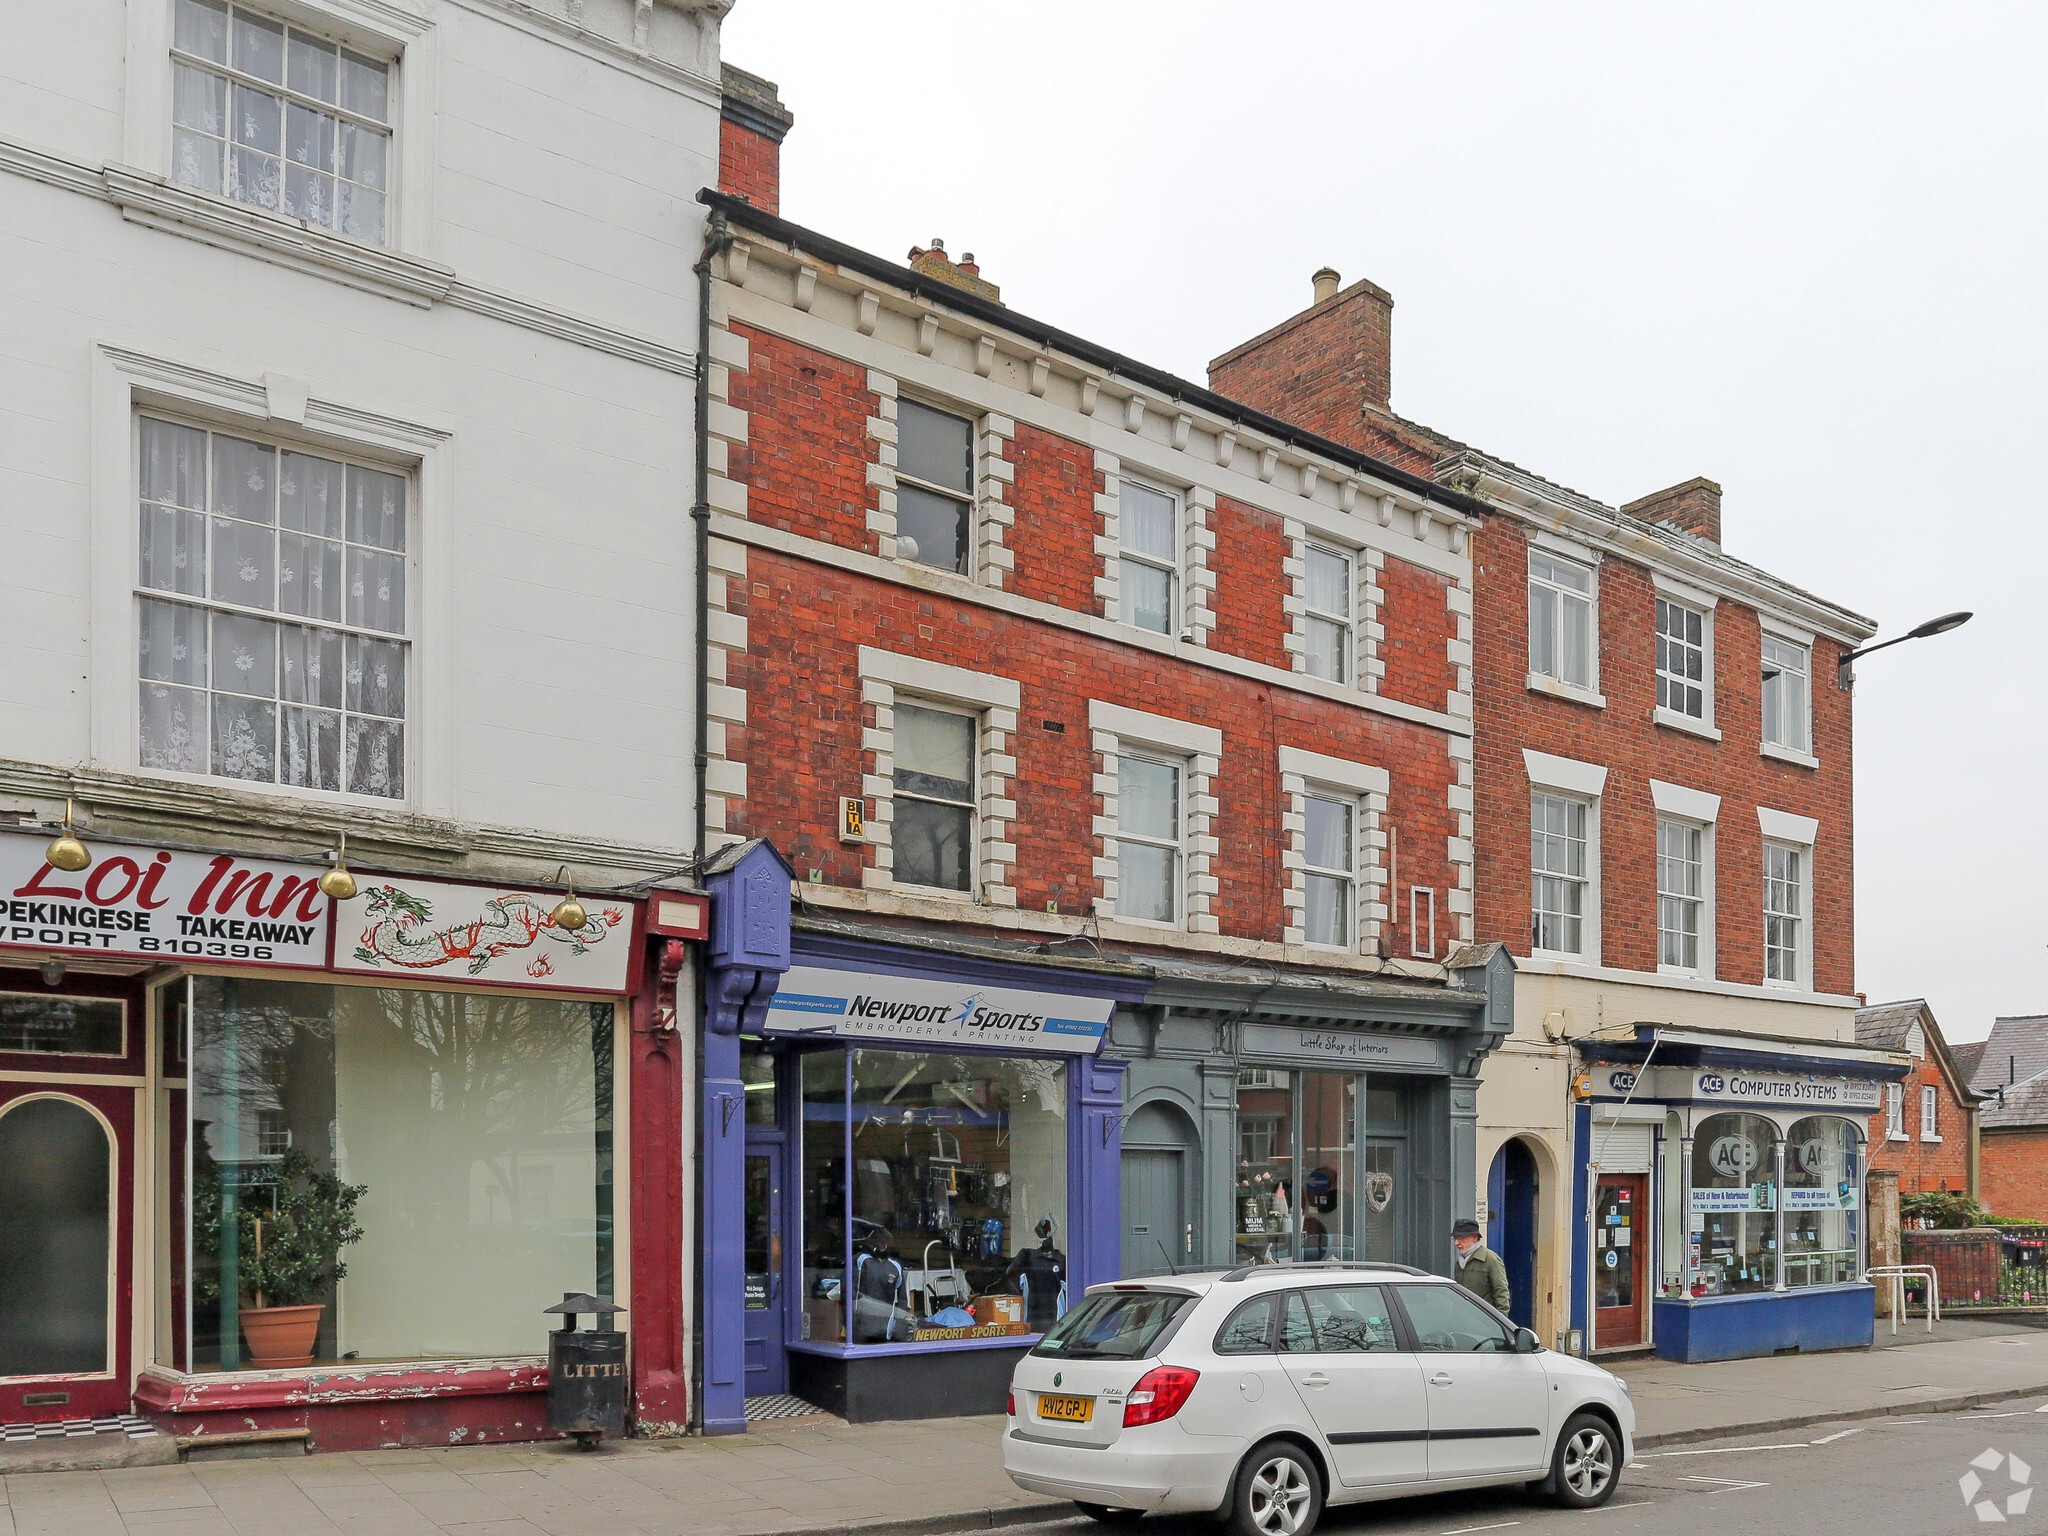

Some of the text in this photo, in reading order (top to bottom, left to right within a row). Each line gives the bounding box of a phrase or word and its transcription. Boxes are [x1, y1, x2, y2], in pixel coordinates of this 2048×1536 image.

[13, 851, 323, 922] Loi Inn
[176, 915, 316, 946] TAKEAWAY
[0, 926, 273, 960] PORT 810396
[774, 999, 841, 1010] www.newportsports.co.uk
[848, 995, 1043, 1032] Newport Sports
[845, 1021, 943, 1036] EMBROIDERY
[968, 1031, 1035, 1043] PRINTING
[1300, 1033, 1389, 1055] Little Shop of Interiors
[1613, 1074, 1634, 1088] ACE
[1702, 1077, 1721, 1091] ACE
[1718, 1143, 1750, 1166] ACE
[915, 1327, 966, 1341] NEWPORT
[970, 1325, 1007, 1338] SPORTS
